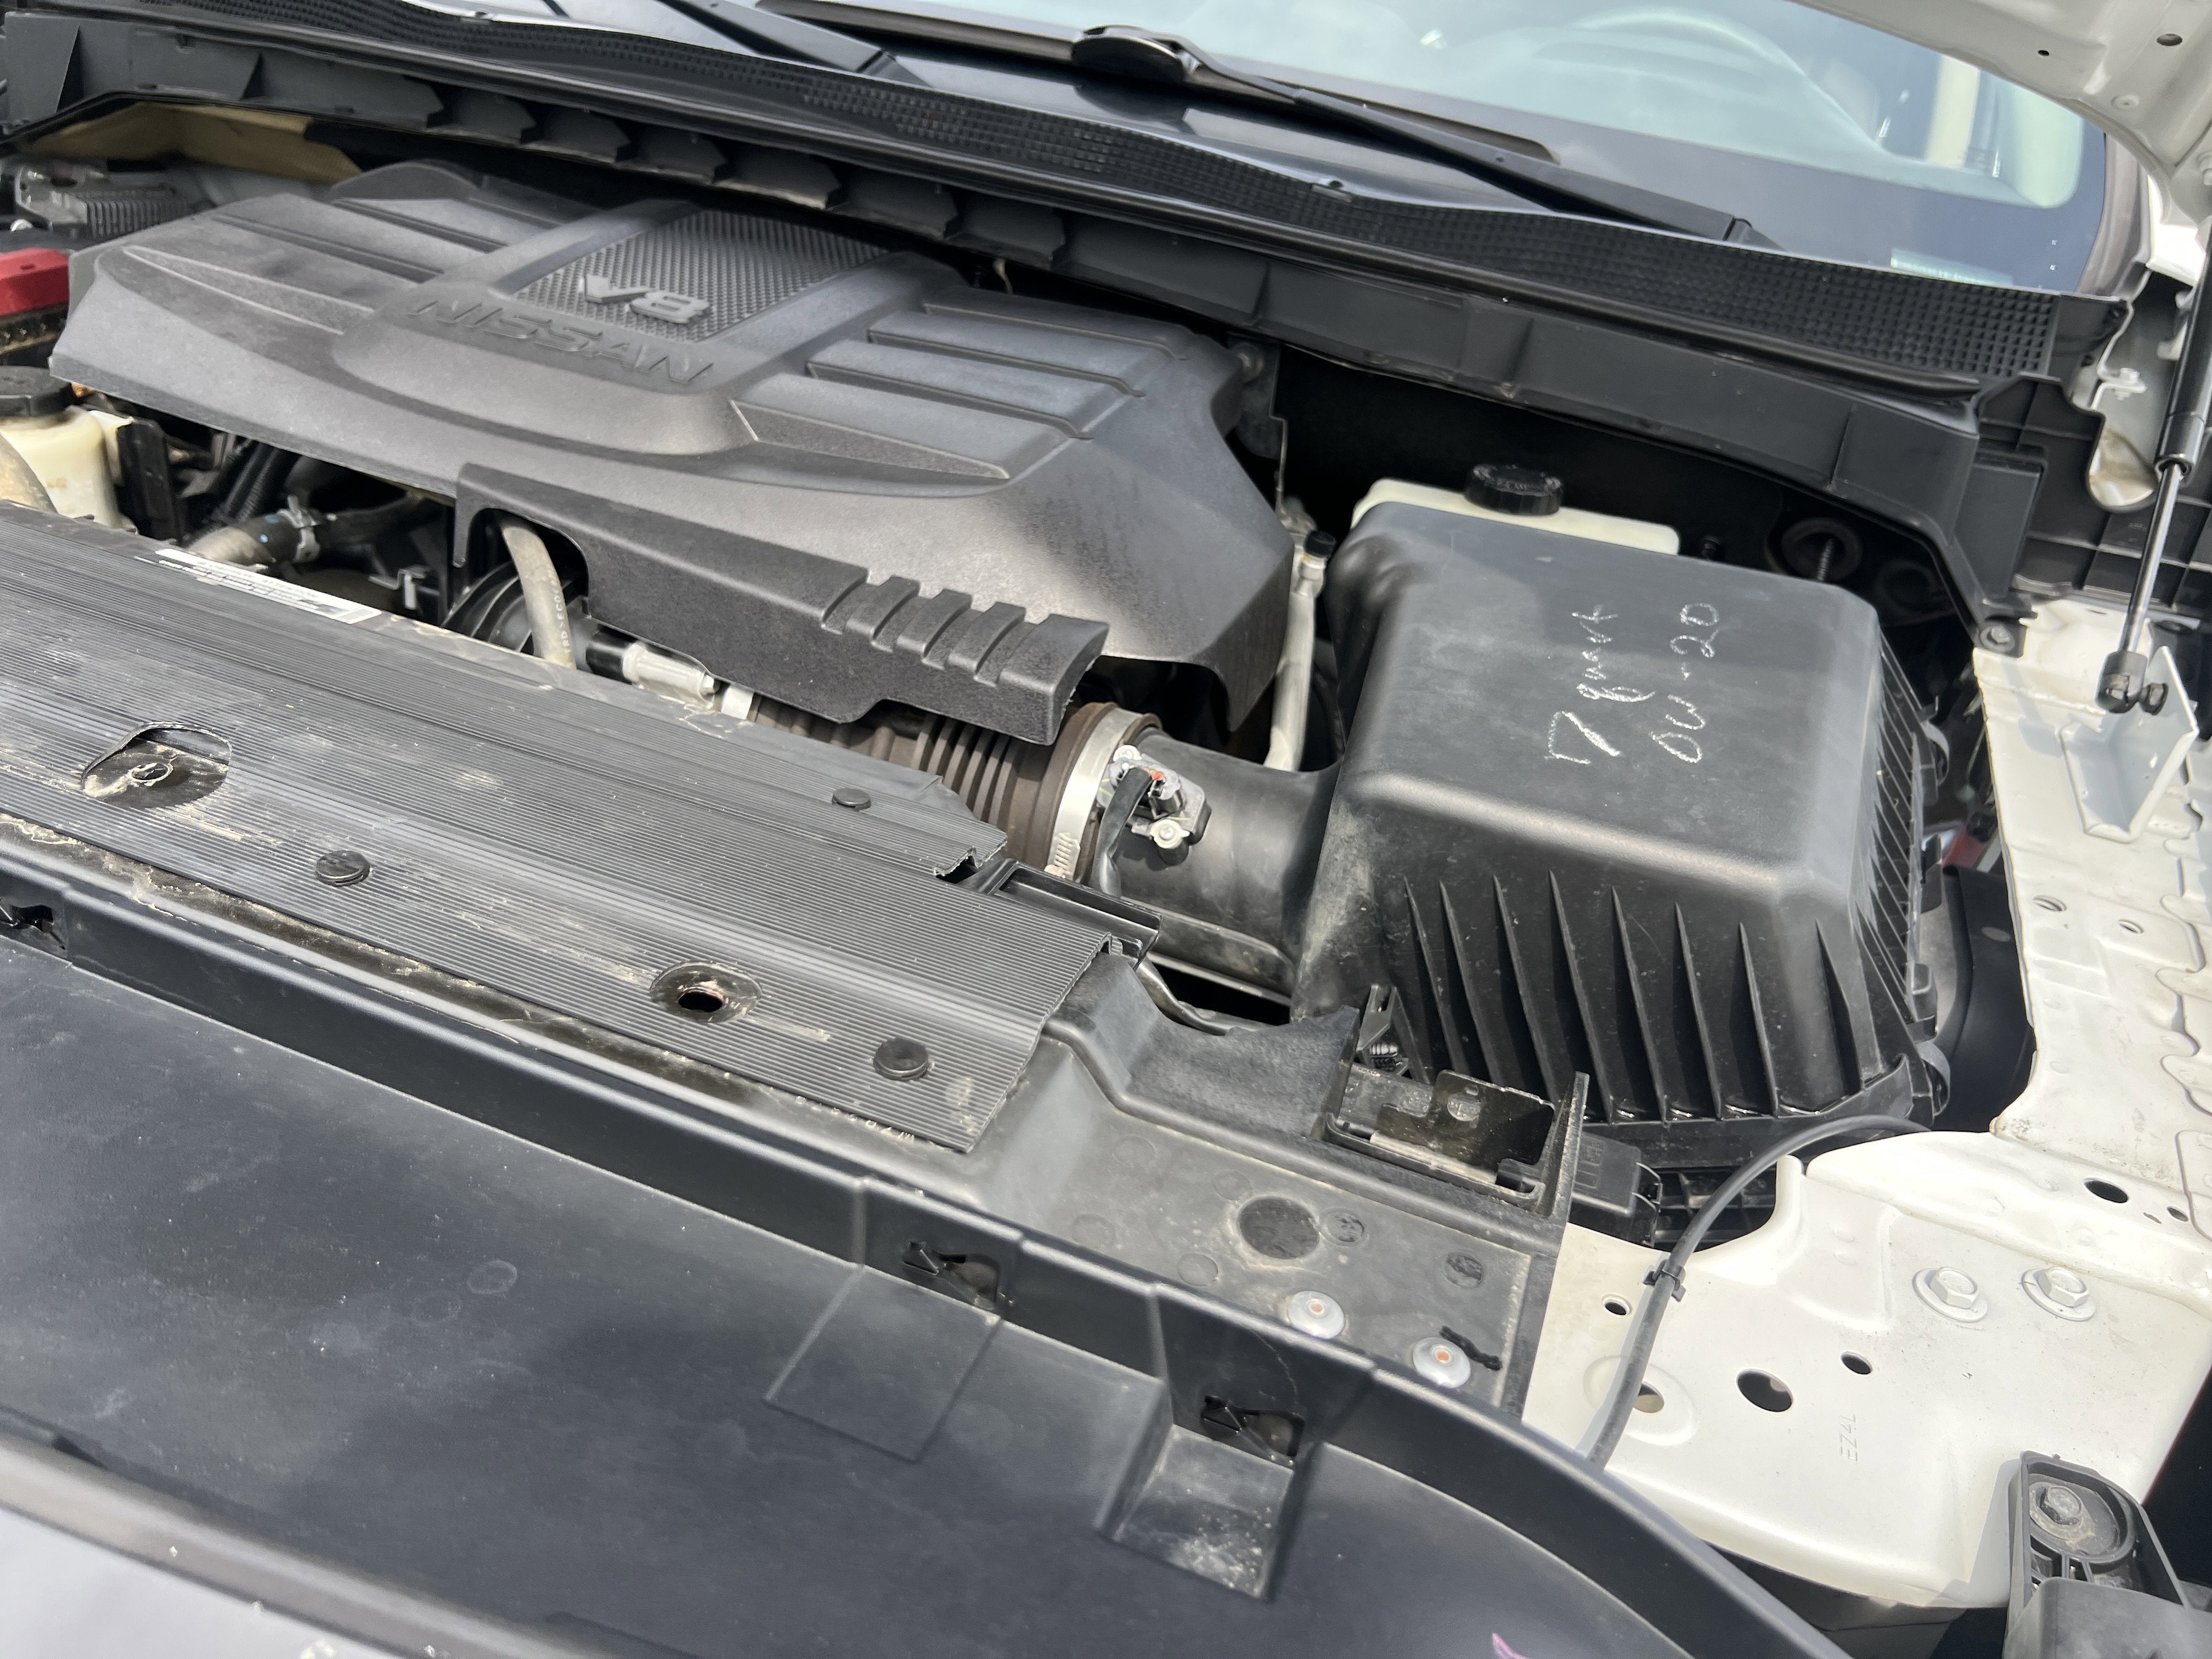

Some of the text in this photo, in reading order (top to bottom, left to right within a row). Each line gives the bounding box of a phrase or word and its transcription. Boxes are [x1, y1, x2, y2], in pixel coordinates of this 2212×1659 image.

[583, 273, 711, 324] V8
[407, 299, 714, 384] NISSAN
[1839, 1413, 1858, 1462] EZ4L
